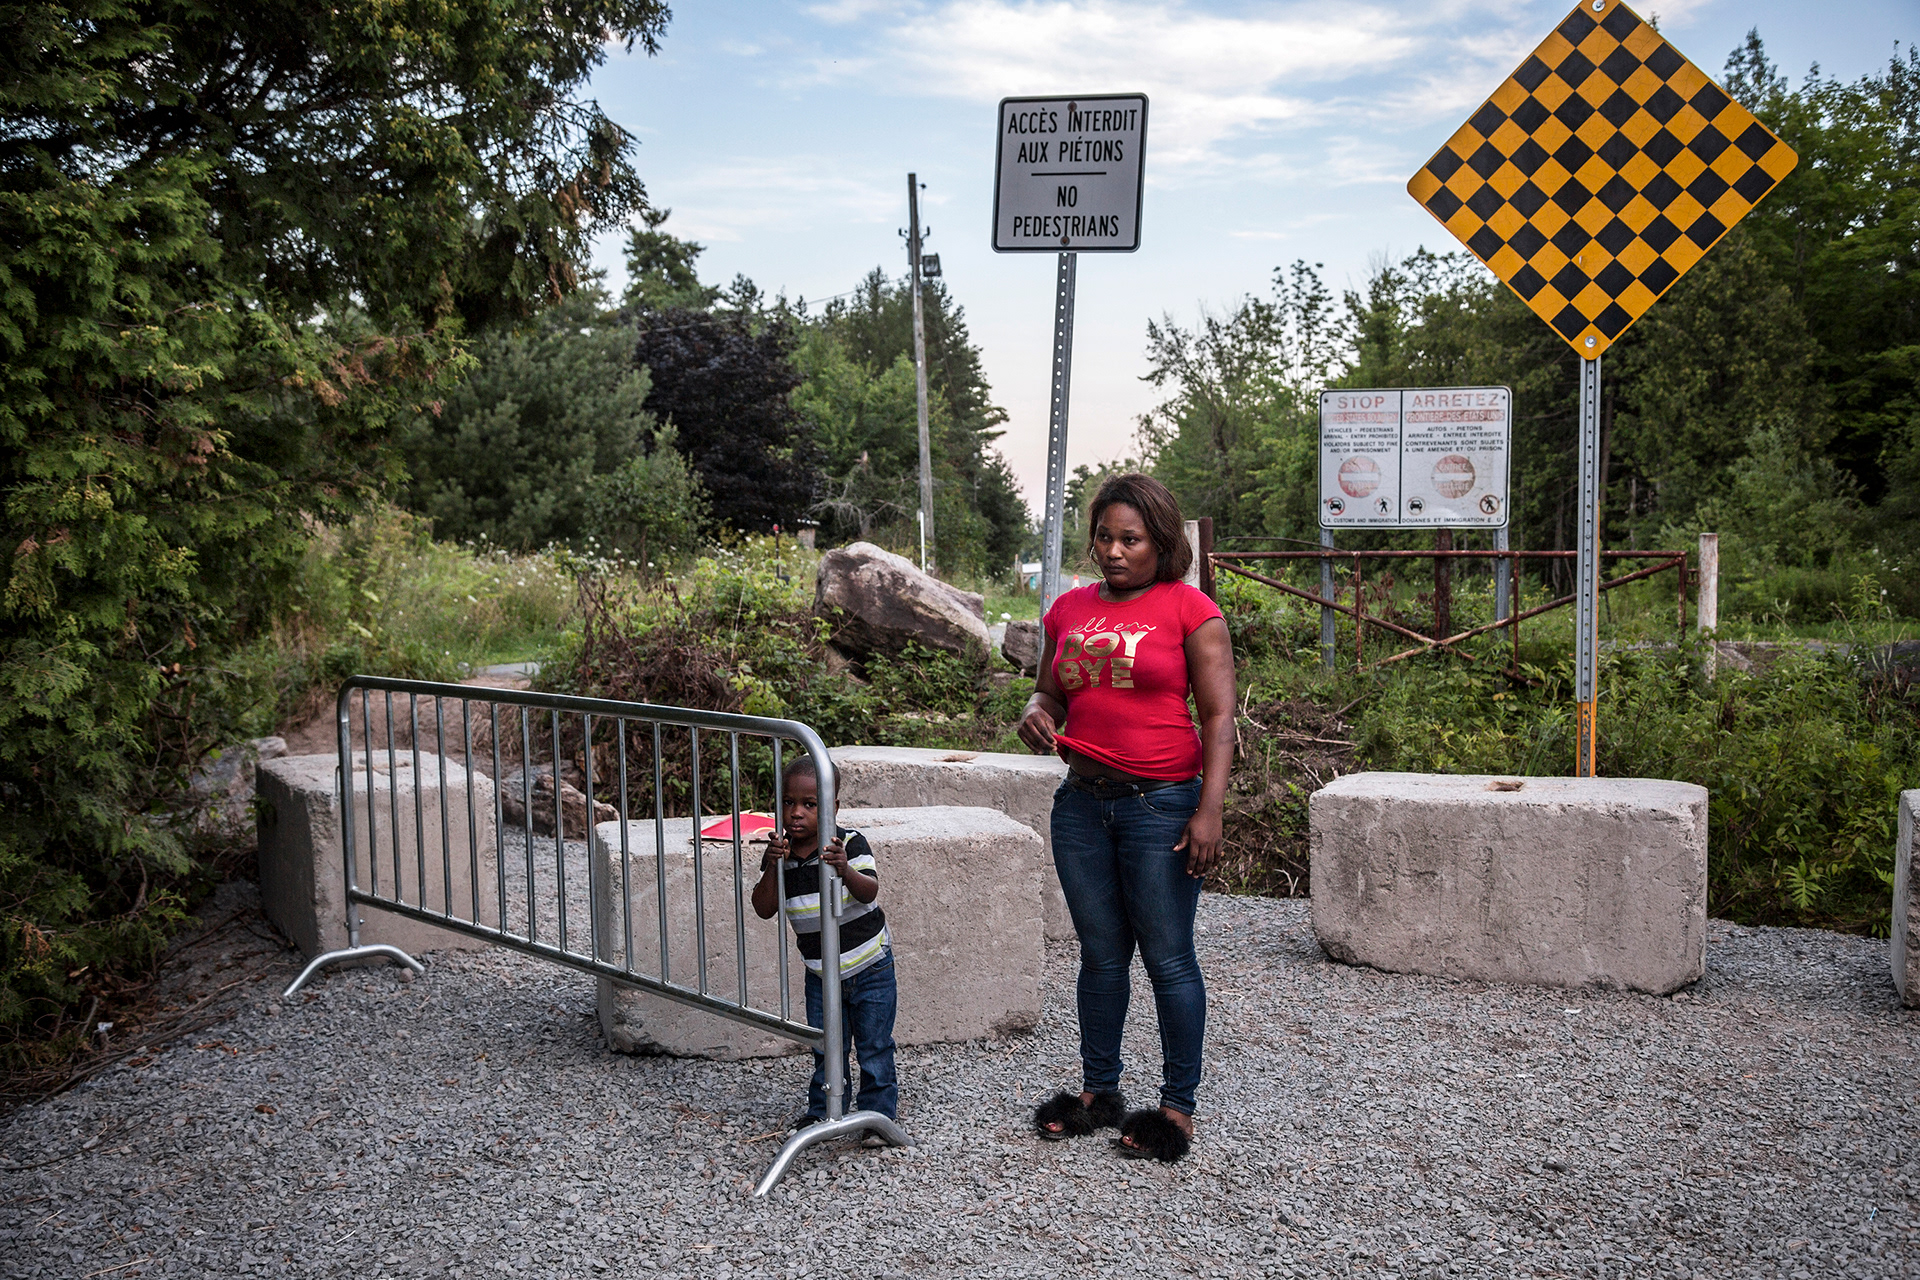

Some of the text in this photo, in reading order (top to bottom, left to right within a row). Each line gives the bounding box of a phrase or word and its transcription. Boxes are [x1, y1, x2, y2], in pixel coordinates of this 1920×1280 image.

[1007, 107, 1137, 134] ACCÈS INTERDIT
[1017, 136, 1124, 164] AUX PIÉTONS
[1056, 185, 1078, 208] NO
[1013, 215, 1119, 238] PEDESTRIANS
[1337, 396, 1385, 409] STOP
[1412, 393, 1499, 408] ARRETEZ
[1068, 616, 1157, 634] tell em
[1060, 631, 1149, 660] BOY
[1058, 657, 1135, 690] BYE
